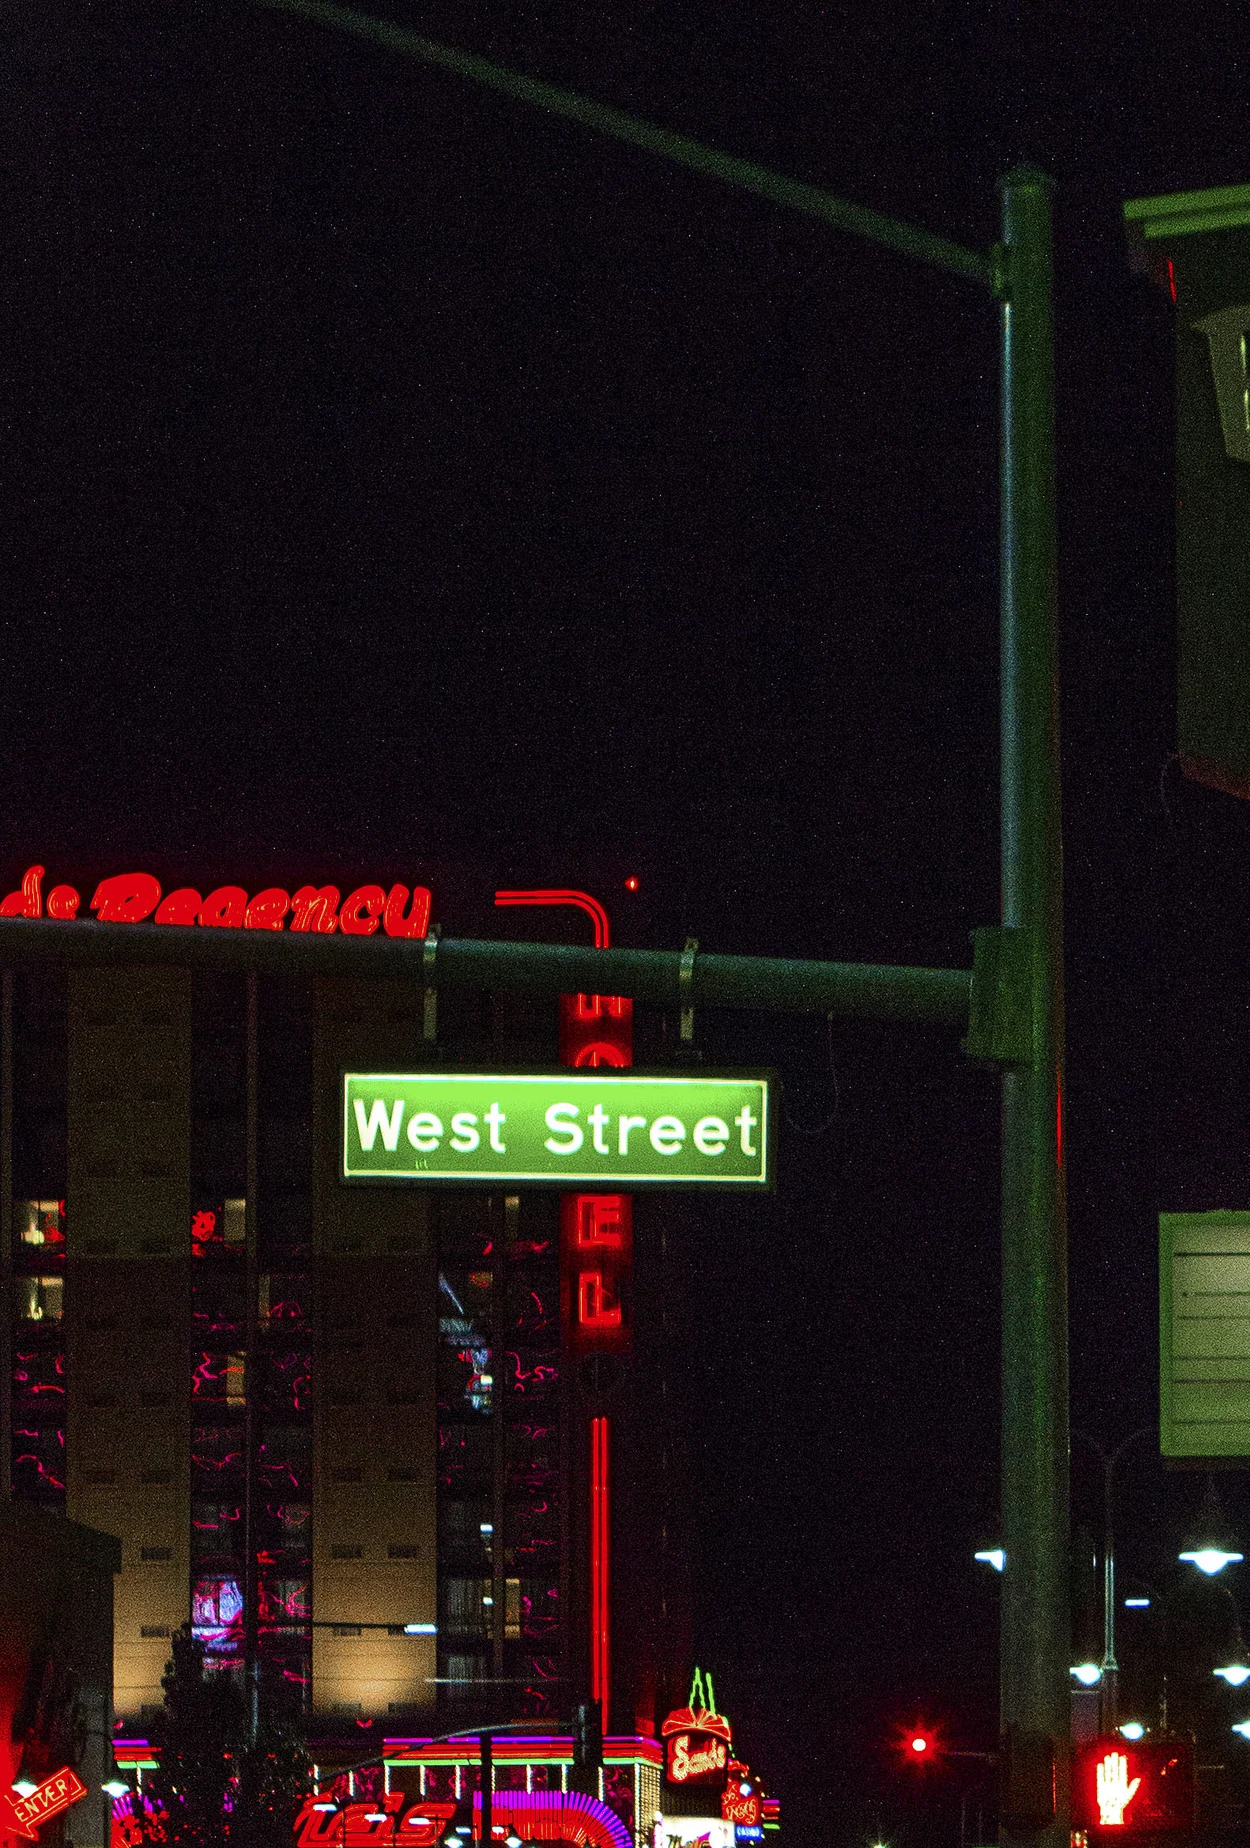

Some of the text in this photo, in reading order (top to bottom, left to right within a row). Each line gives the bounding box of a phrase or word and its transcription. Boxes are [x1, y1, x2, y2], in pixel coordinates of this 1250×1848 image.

[353, 1099, 758, 1158] West Street
[673, 1735, 726, 1780] Sands
[14, 1778, 68, 1822] ENTER
